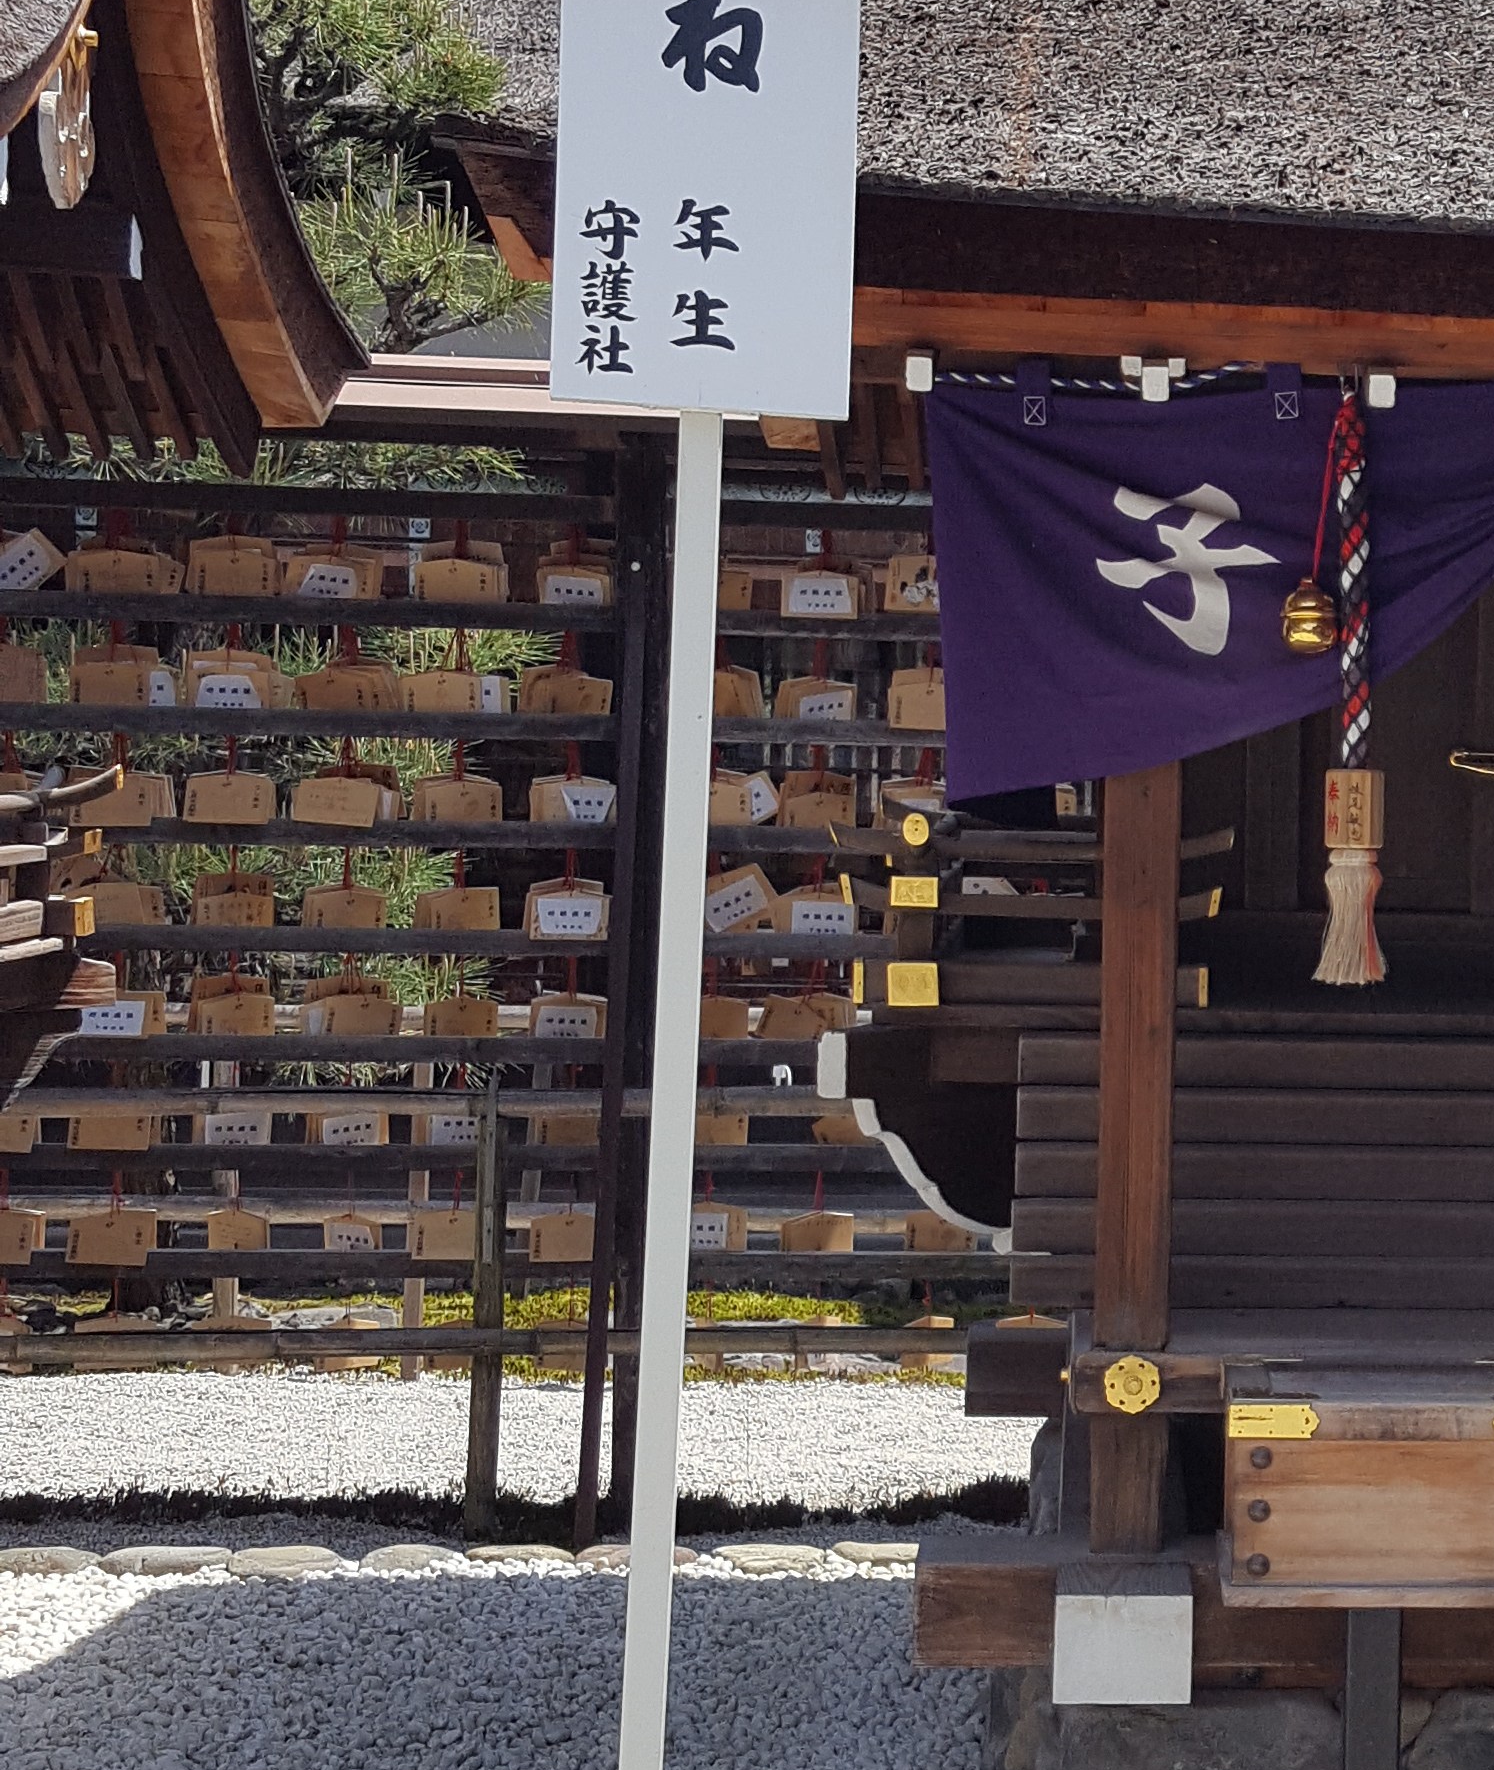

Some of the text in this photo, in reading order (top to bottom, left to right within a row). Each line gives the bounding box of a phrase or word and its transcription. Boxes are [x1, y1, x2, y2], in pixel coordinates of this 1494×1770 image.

[575, 199, 641, 375] 守護社
[670, 198, 740, 351] 年生
[1096, 482, 1281, 656] 子
